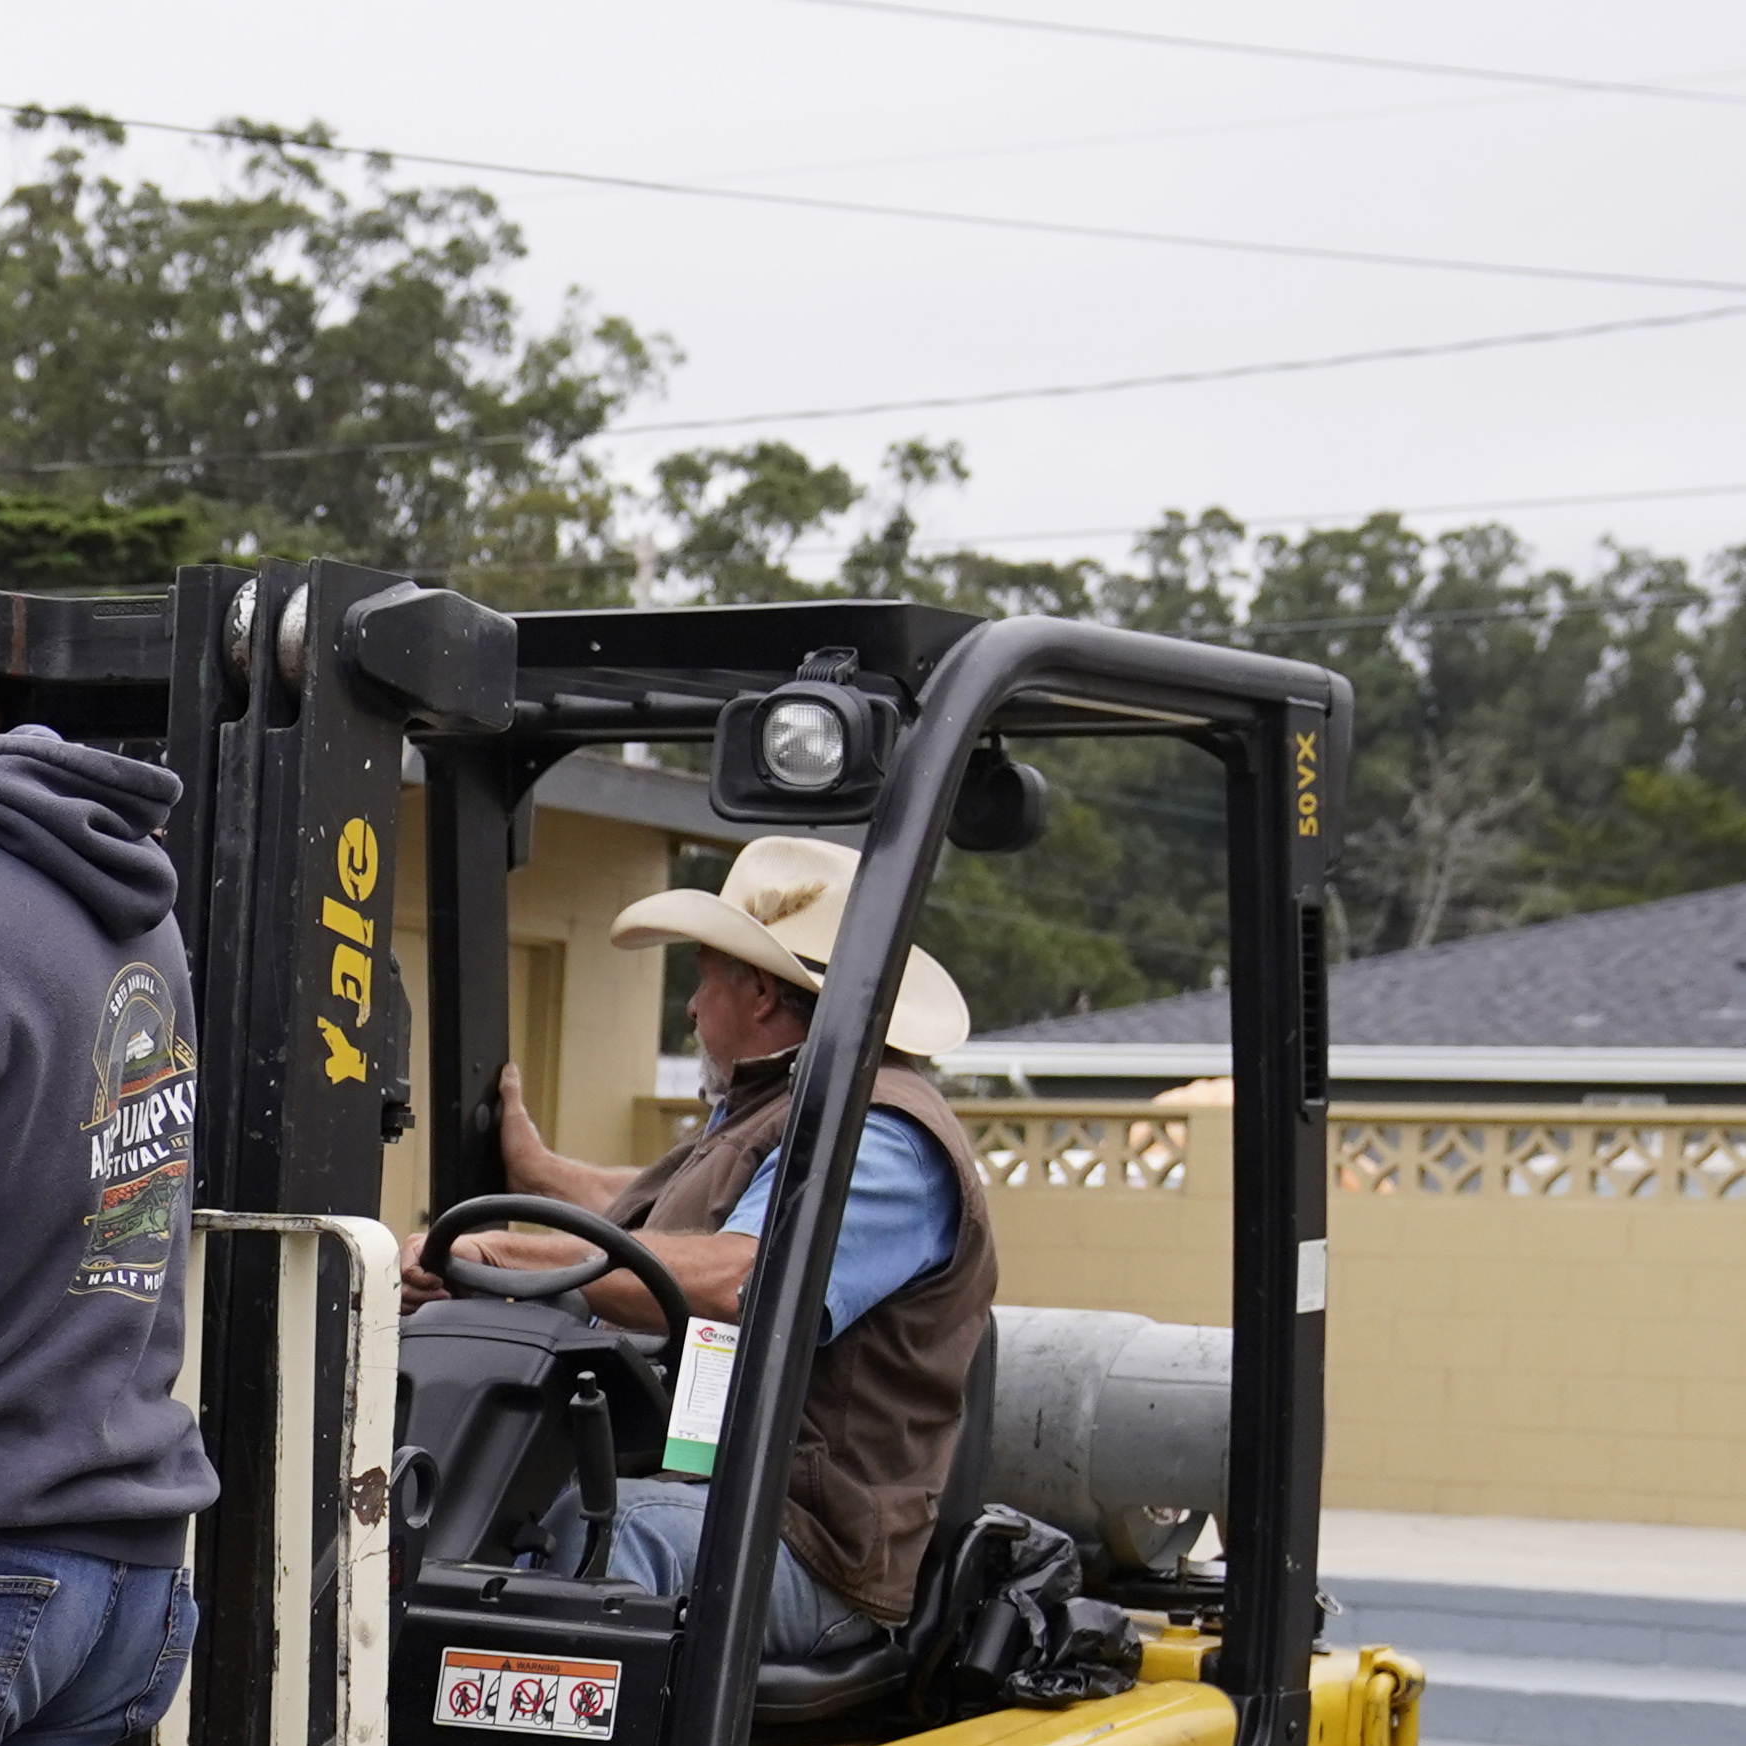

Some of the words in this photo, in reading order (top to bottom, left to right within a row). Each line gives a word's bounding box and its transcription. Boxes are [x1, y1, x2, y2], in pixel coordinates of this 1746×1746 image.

[317, 816, 378, 1085] Yale
[109, 1080, 196, 1153] PUMPKI
[106, 1141, 170, 1180] STIVAL
[88, 1270, 138, 1287] HALF
[516, 1661, 560, 1673] WARNING
